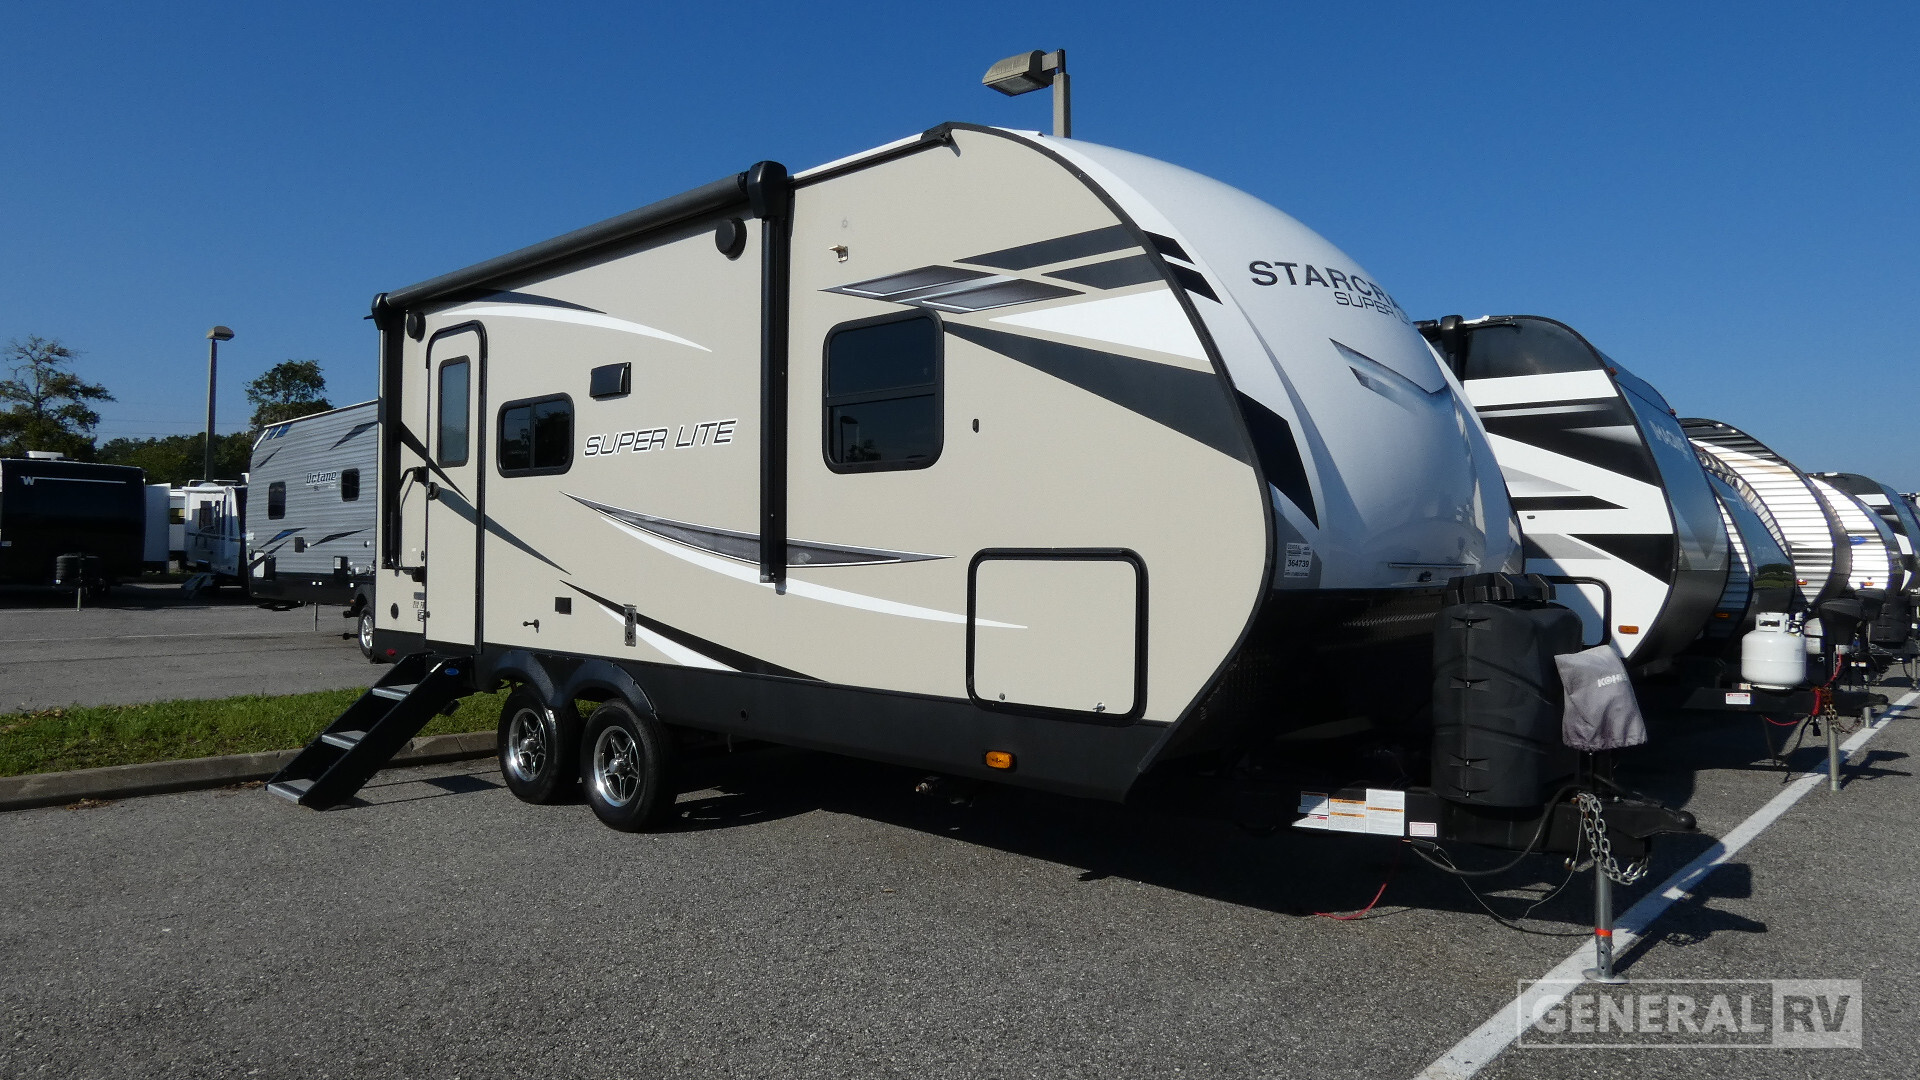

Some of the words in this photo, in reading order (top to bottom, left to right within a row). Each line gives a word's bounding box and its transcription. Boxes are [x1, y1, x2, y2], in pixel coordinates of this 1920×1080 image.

[1249, 260, 1403, 313] STARCR
[1334, 291, 1397, 319] SUPER
[584, 427, 668, 457] SUPER
[674, 418, 738, 449] LITE
[306, 471, 338, 485] Octane
